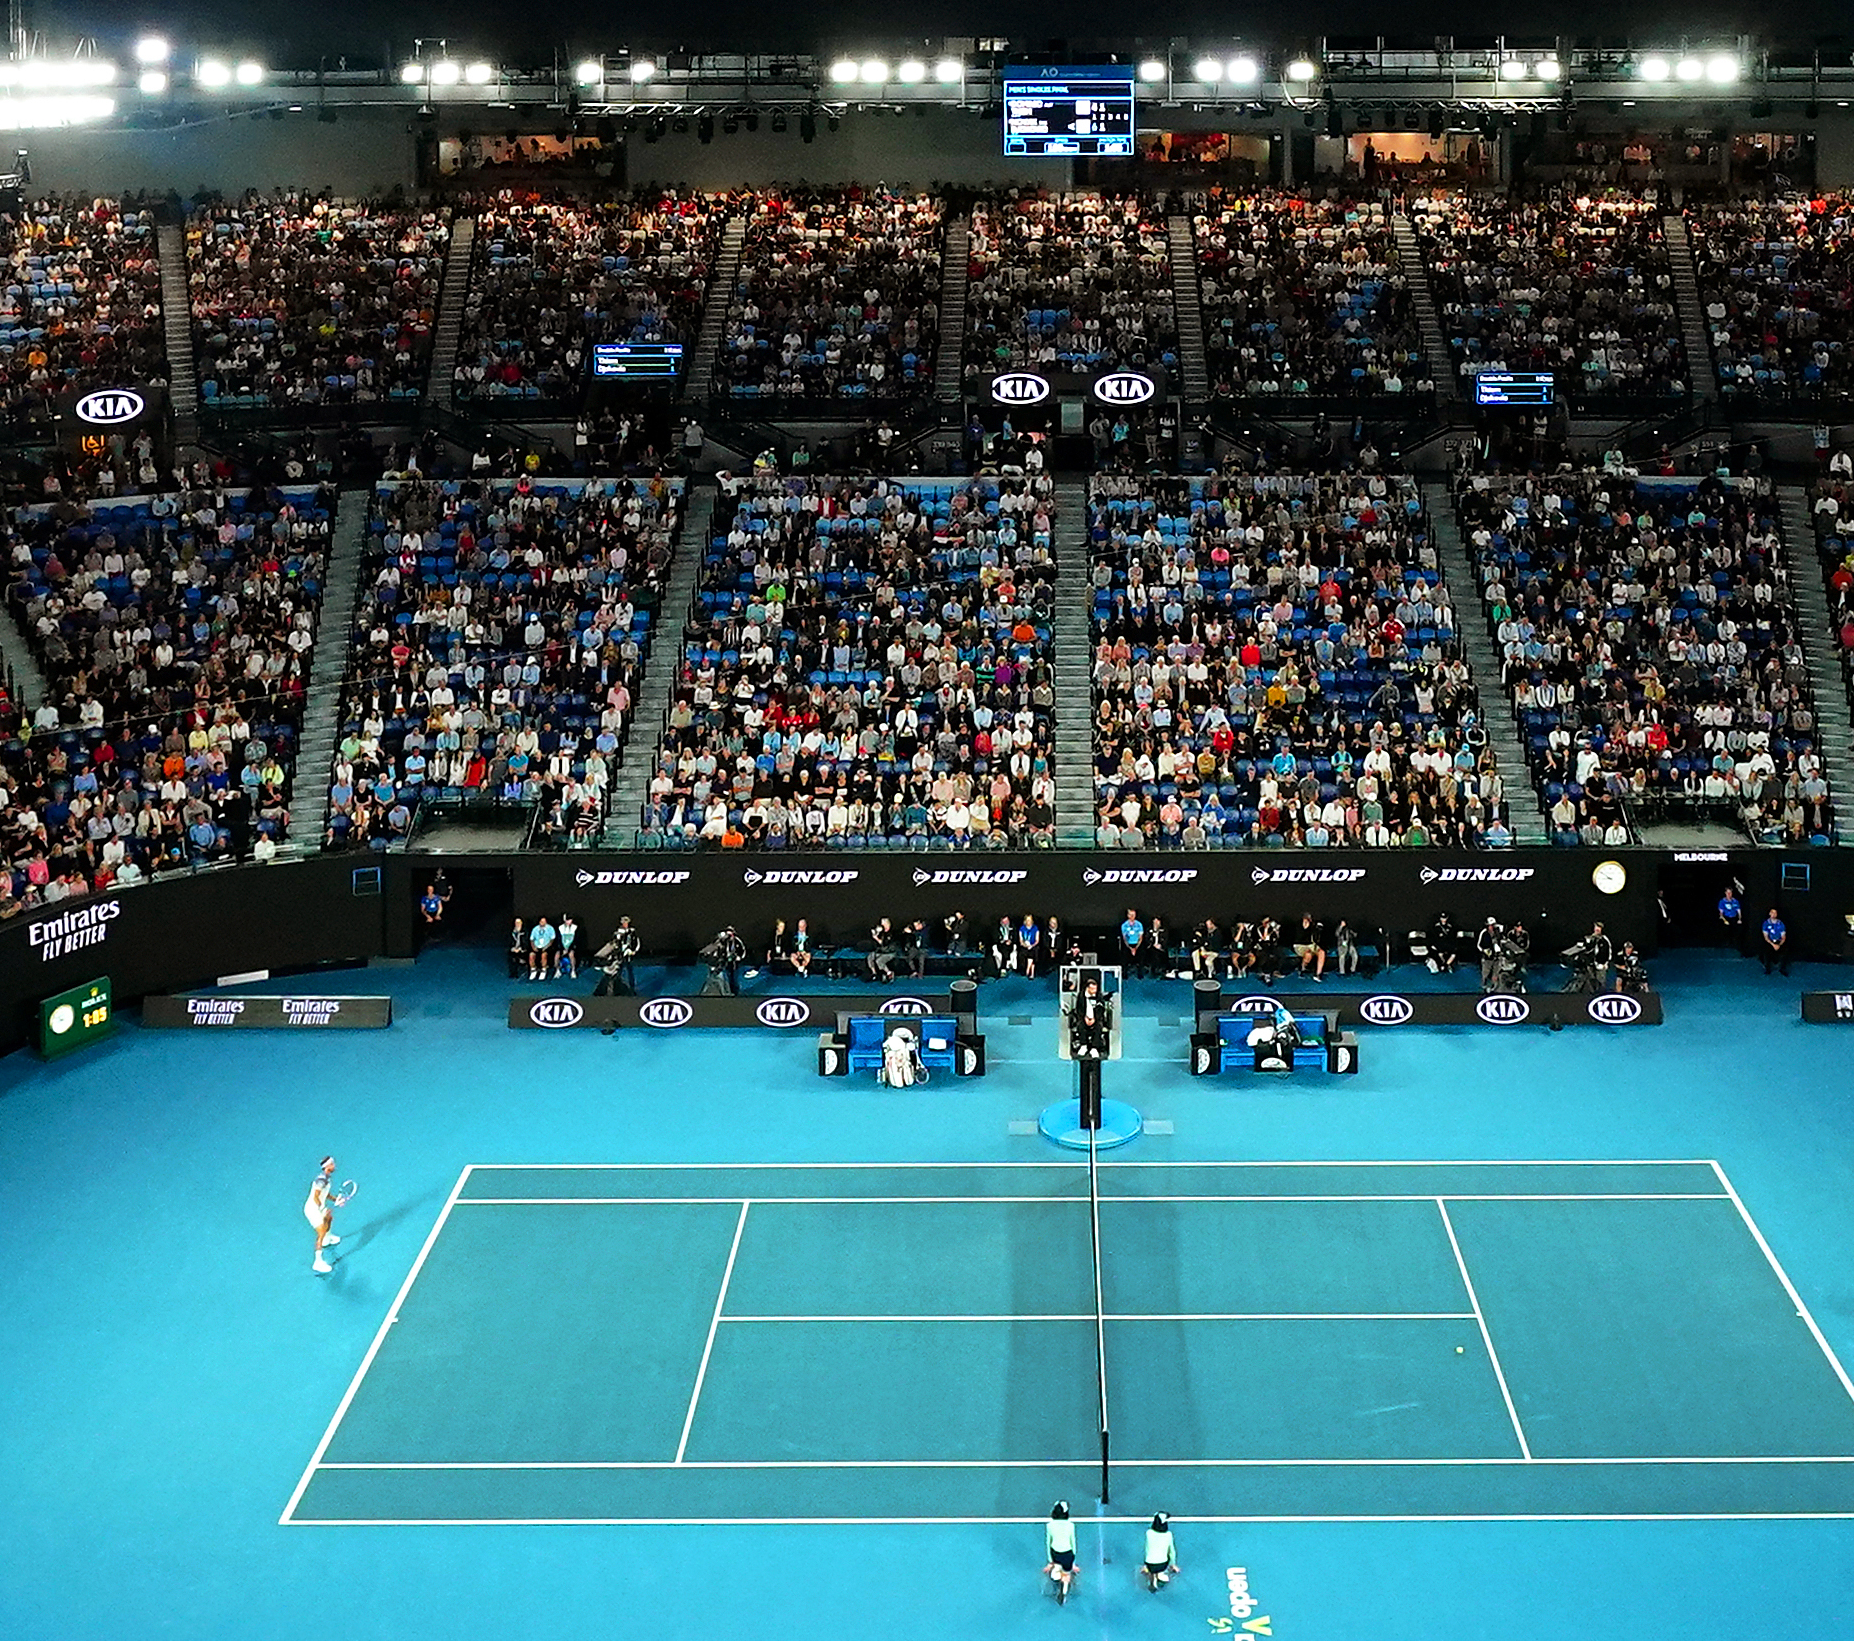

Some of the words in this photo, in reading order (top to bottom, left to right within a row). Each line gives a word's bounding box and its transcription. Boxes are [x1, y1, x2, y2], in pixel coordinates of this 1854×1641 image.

[1000, 380, 1041, 397] KIA
[1105, 380, 1144, 397] KIA
[90, 398, 131, 416] KIA
[595, 871, 691, 884] DUNLOP
[763, 871, 859, 884] DUNLOP
[931, 870, 1027, 883] DUNLOP
[1102, 870, 1198, 883] DUNLOP
[1270, 869, 1366, 882] DUNLOP
[1438, 869, 1534, 882] DUNLOP
[29, 901, 120, 946] Emirates
[43, 938, 62, 961] FLY
[64, 924, 106, 953] BETTER
[188, 1000, 245, 1013] Emirates
[283, 1000, 339, 1013] Emirates
[539, 1004, 574, 1021] KIA
[649, 1004, 684, 1021] KIA
[766, 1004, 801, 1021] KIA
[1369, 1002, 1404, 1018] KIA
[1485, 1002, 1520, 1018] KIA
[1598, 1001, 1633, 1017] KIA
[1225, 1567, 1259, 1619] open
